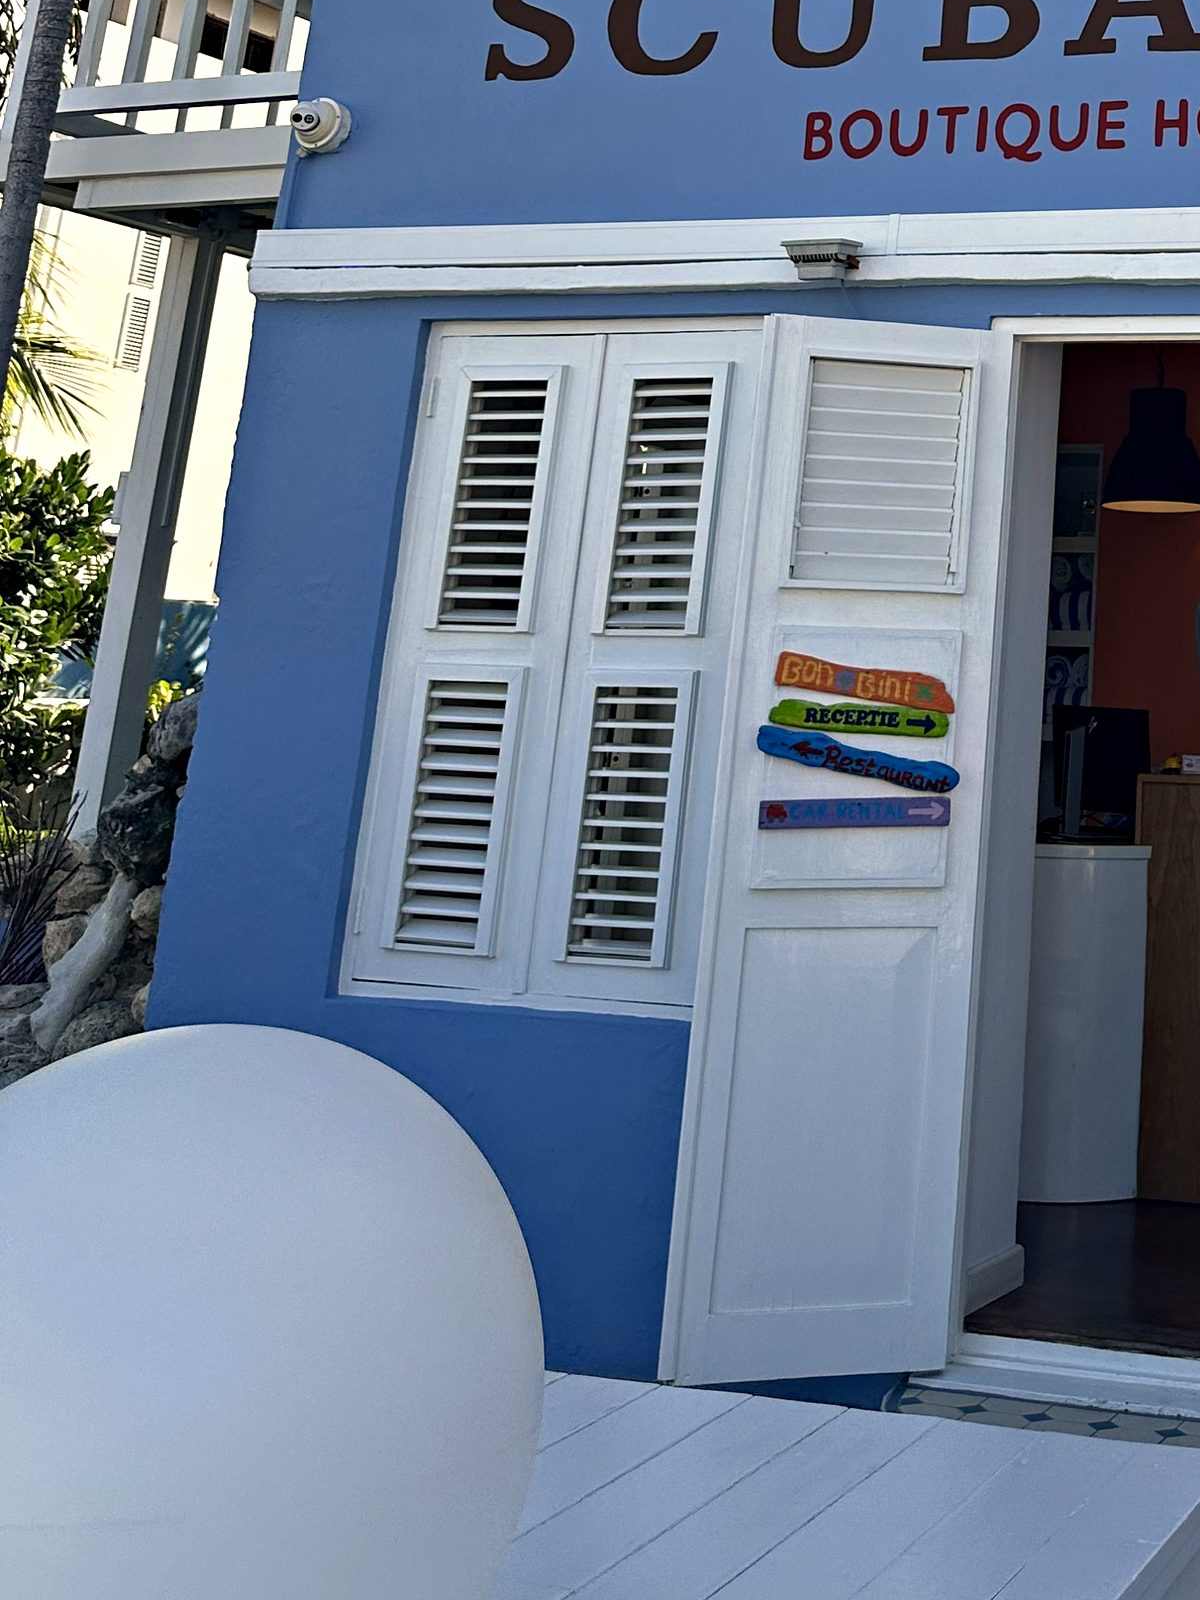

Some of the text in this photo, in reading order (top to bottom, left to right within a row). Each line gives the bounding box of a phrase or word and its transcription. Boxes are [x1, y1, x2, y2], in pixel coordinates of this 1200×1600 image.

[802, 99, 1129, 163] BOUTIQUE
[781, 655, 912, 703] Bon Bini
[803, 707, 901, 729] RECEPTIE
[788, 802, 827, 820] CAR
